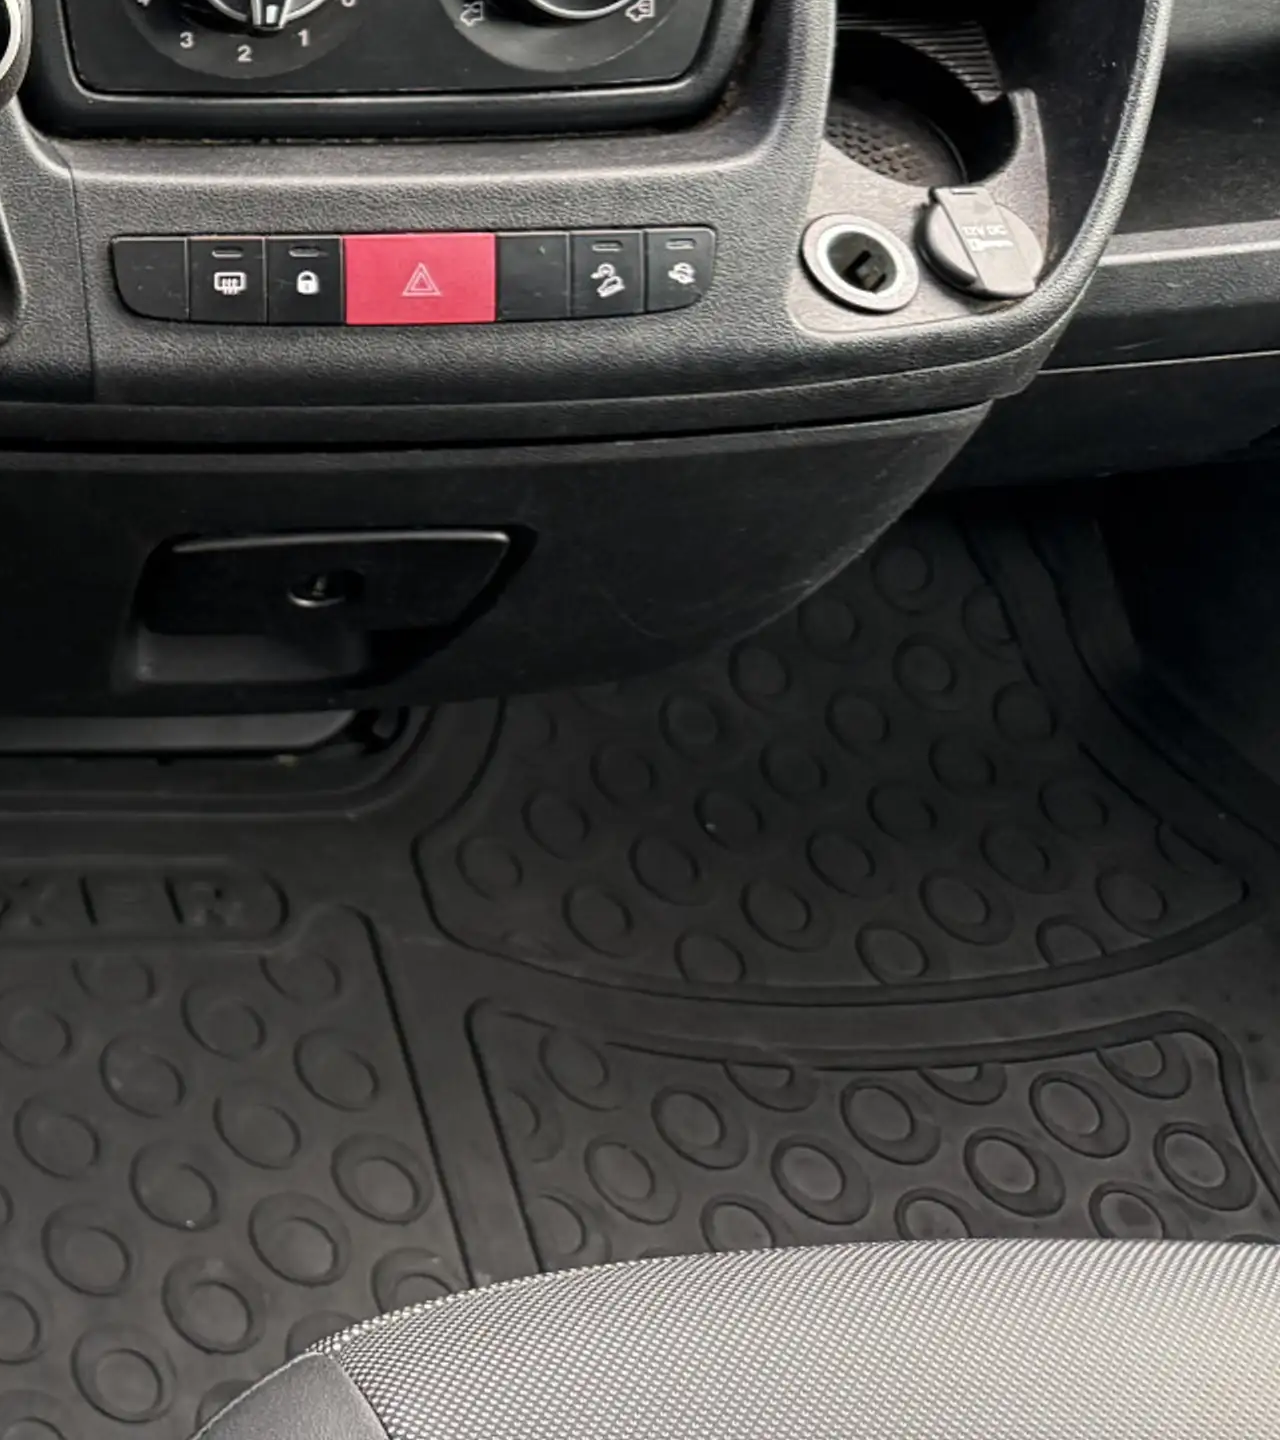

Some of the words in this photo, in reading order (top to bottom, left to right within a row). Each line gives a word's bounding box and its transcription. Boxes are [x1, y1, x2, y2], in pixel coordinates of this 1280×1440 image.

[180, 31, 195, 48] 3
[298, 30, 311, 46] 1
[238, 46, 253, 63] 2
